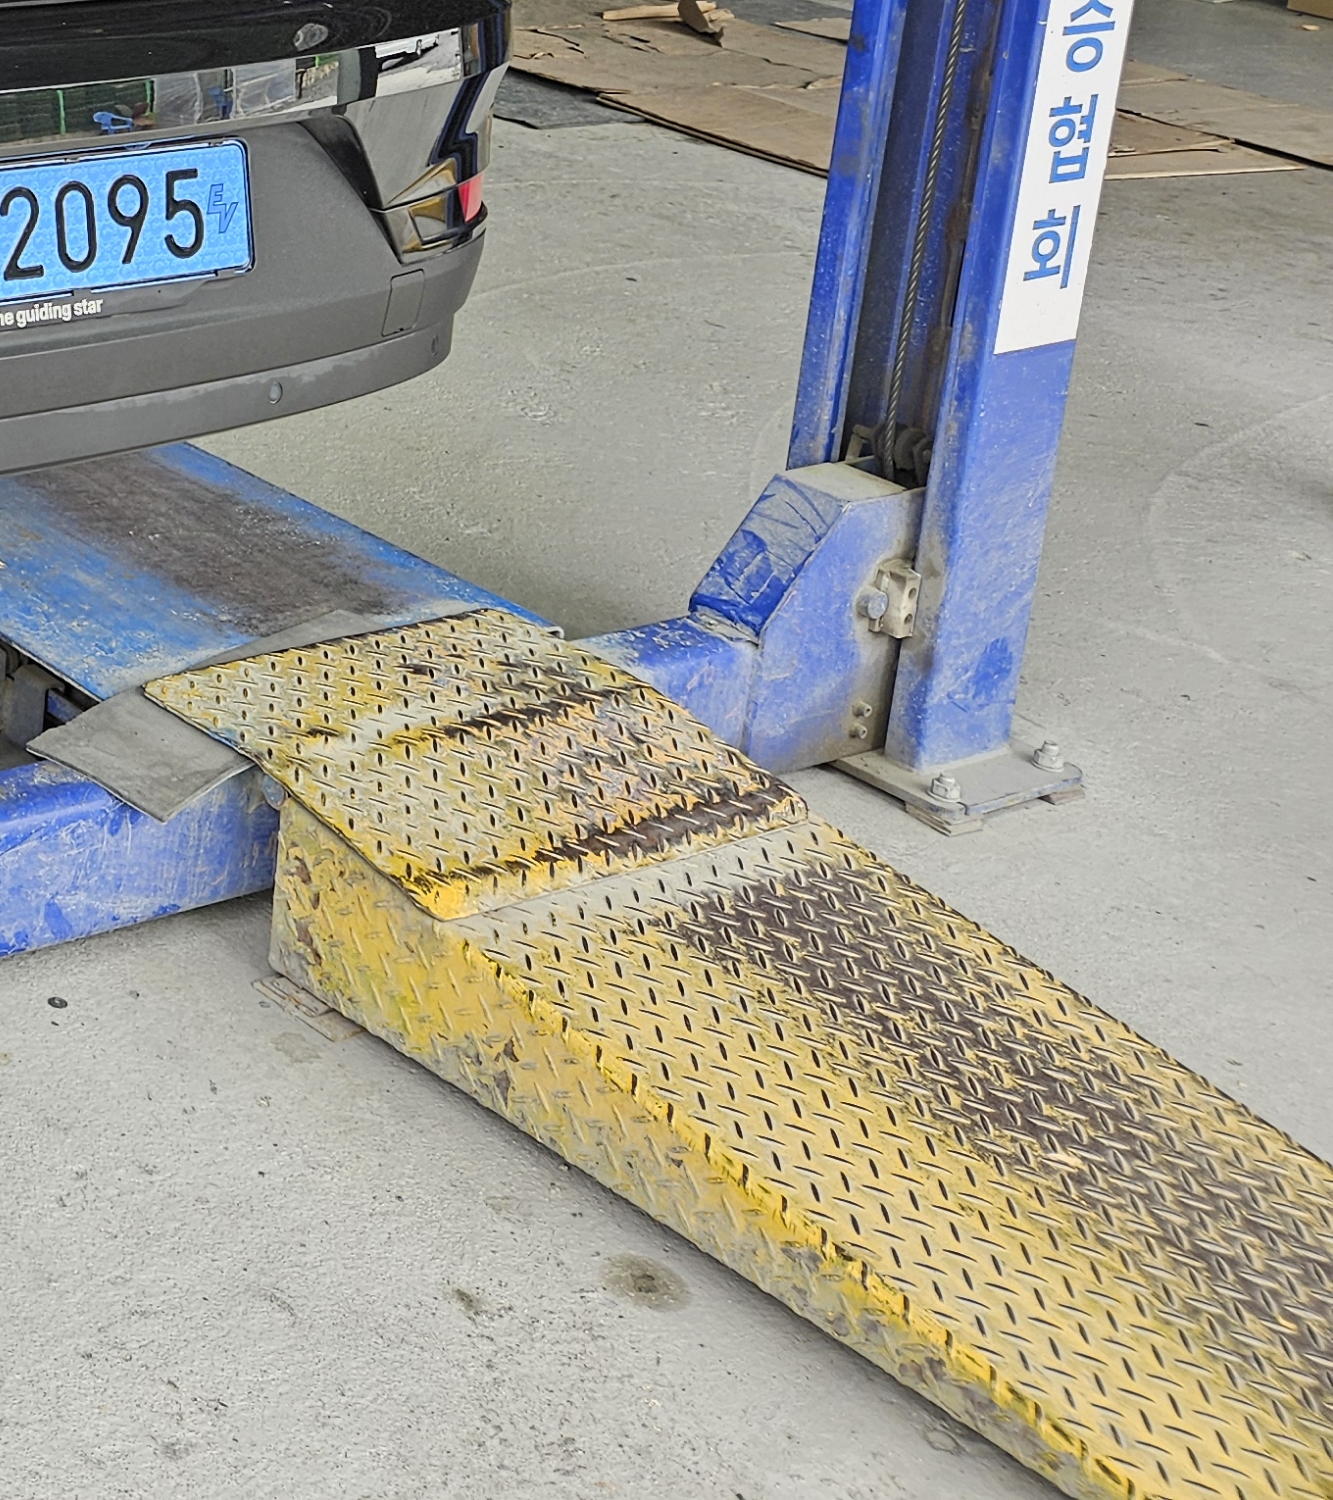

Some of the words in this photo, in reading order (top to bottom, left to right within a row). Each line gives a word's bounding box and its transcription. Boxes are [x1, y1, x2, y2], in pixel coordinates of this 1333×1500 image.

[206, 182, 239, 234] EV
[16, 303, 72, 328] guiding
[73, 299, 104, 316] star
